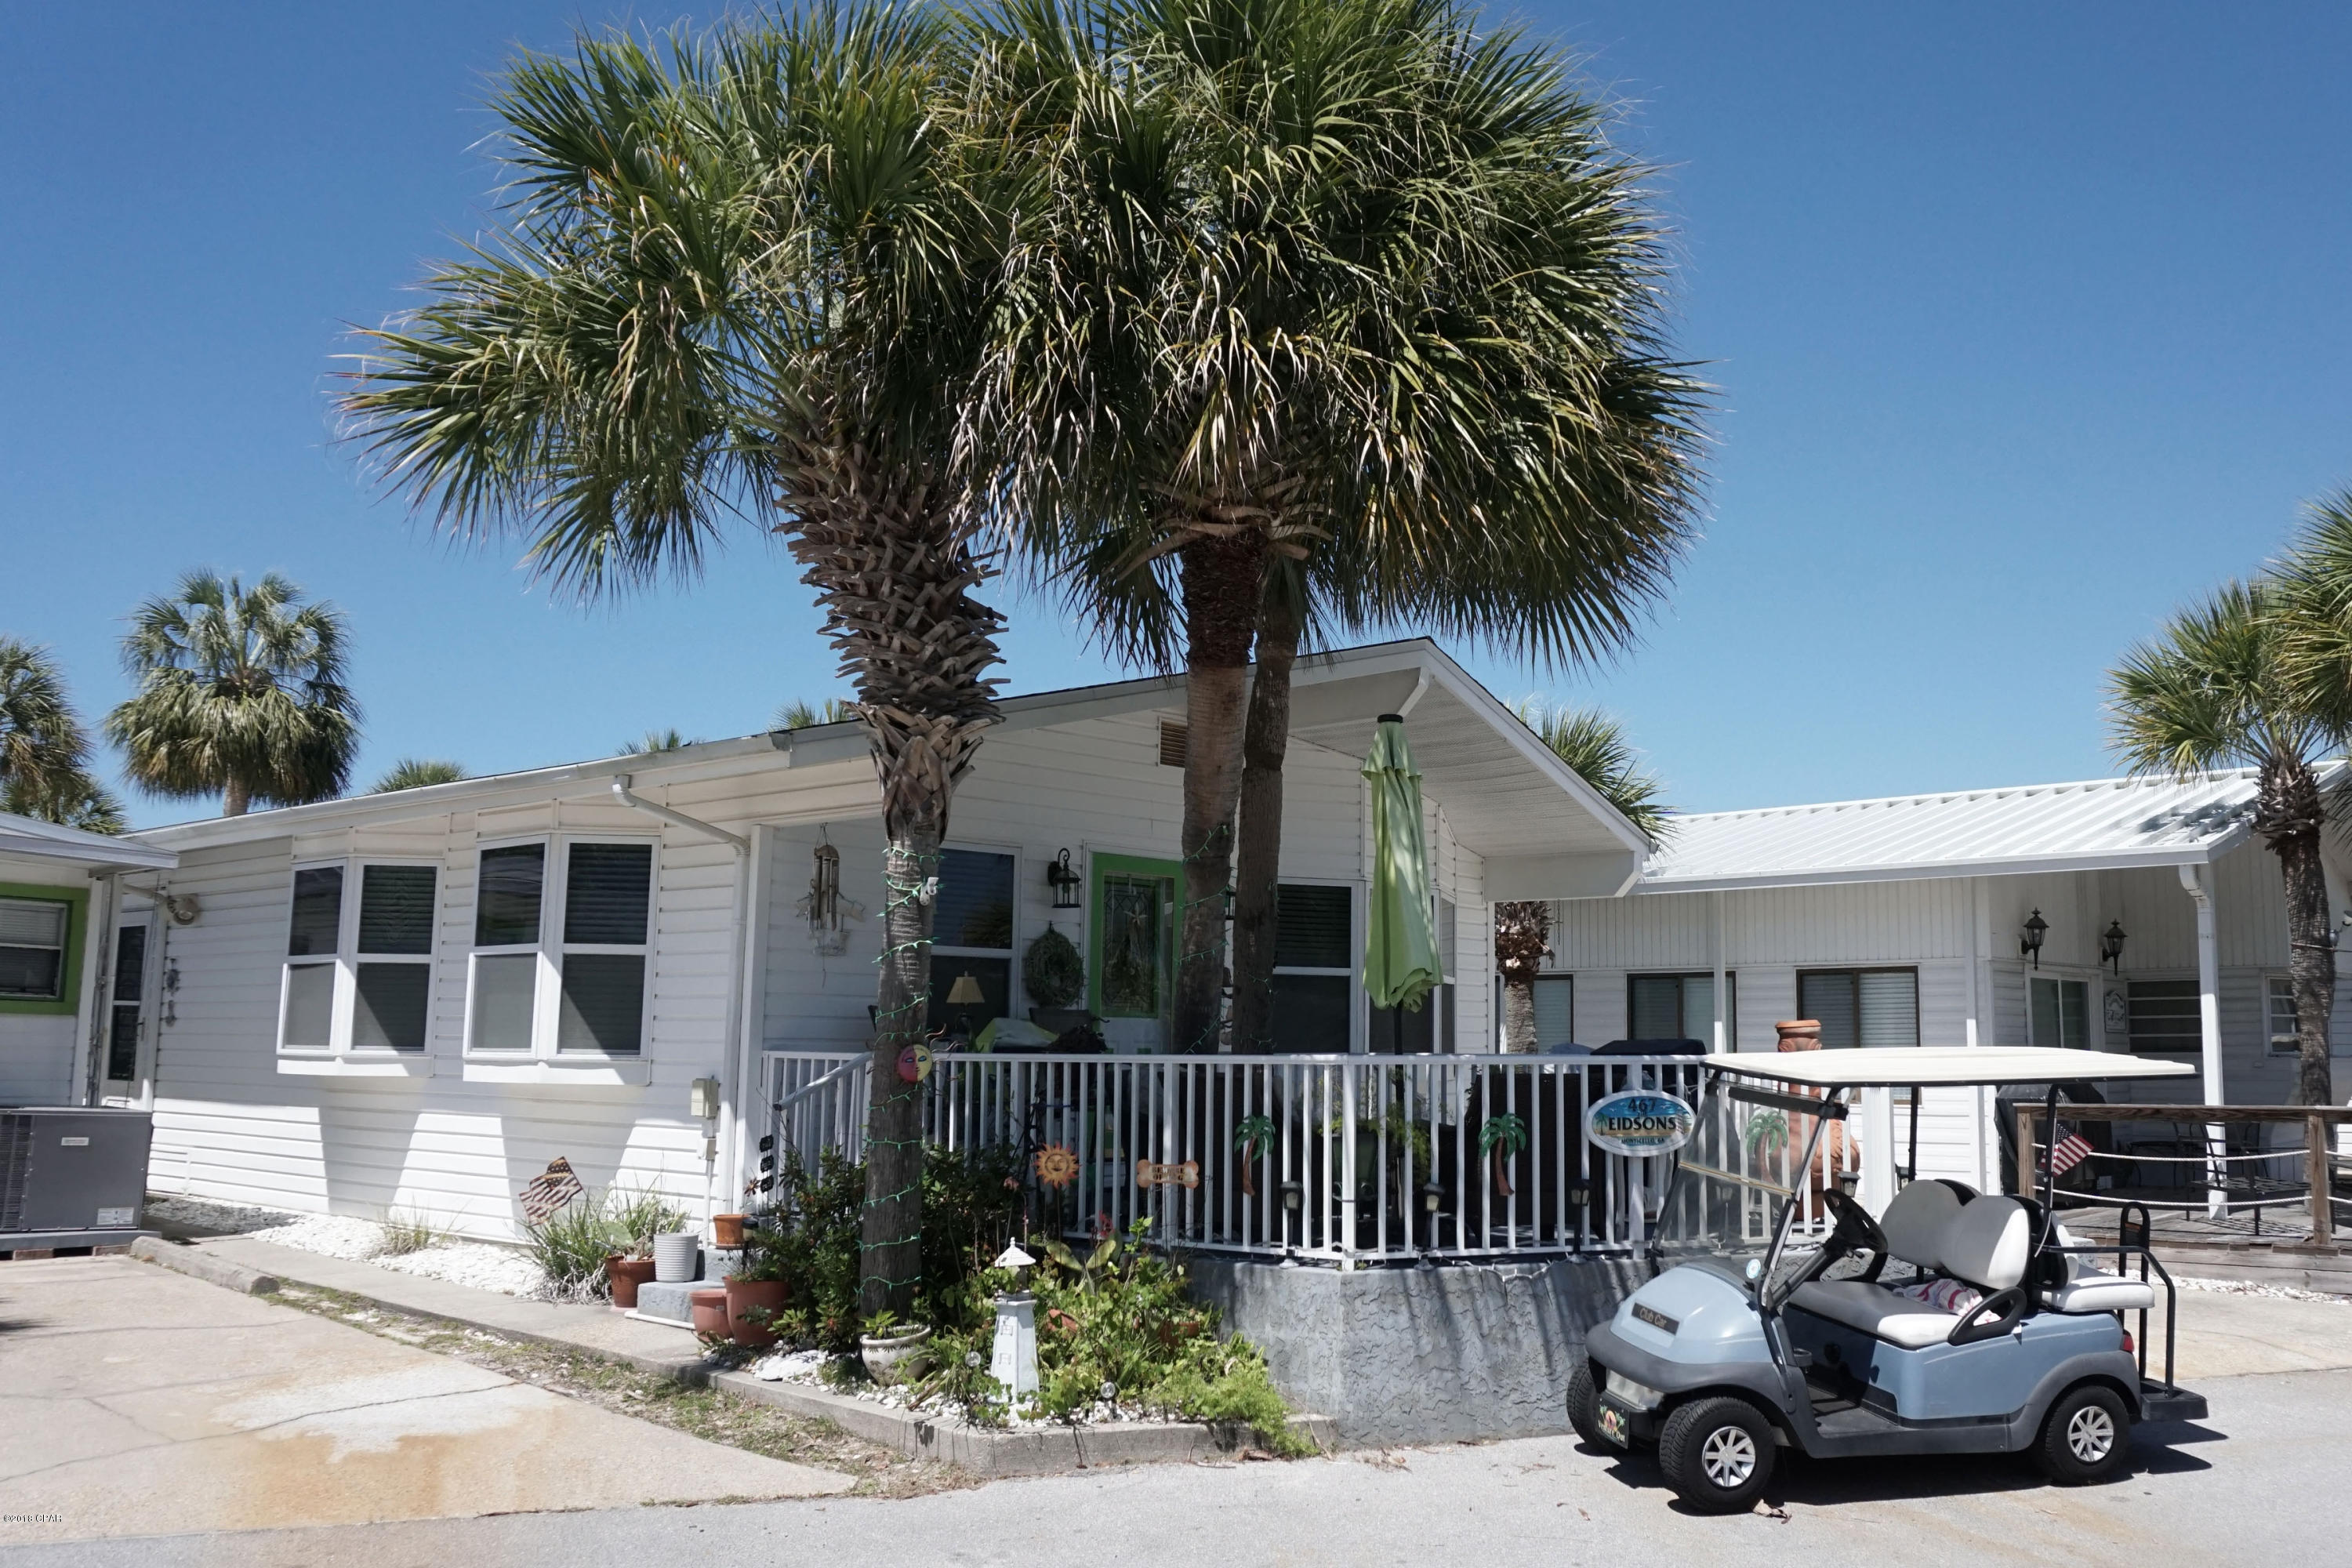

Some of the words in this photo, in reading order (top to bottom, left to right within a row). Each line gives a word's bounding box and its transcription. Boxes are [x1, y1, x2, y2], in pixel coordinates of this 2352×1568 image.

[1628, 1098, 1657, 1112] 467
[1608, 1116, 1676, 1131] EIDSONS
[1639, 1308, 1654, 1323] Club
[1654, 1314, 1668, 1328] Car
